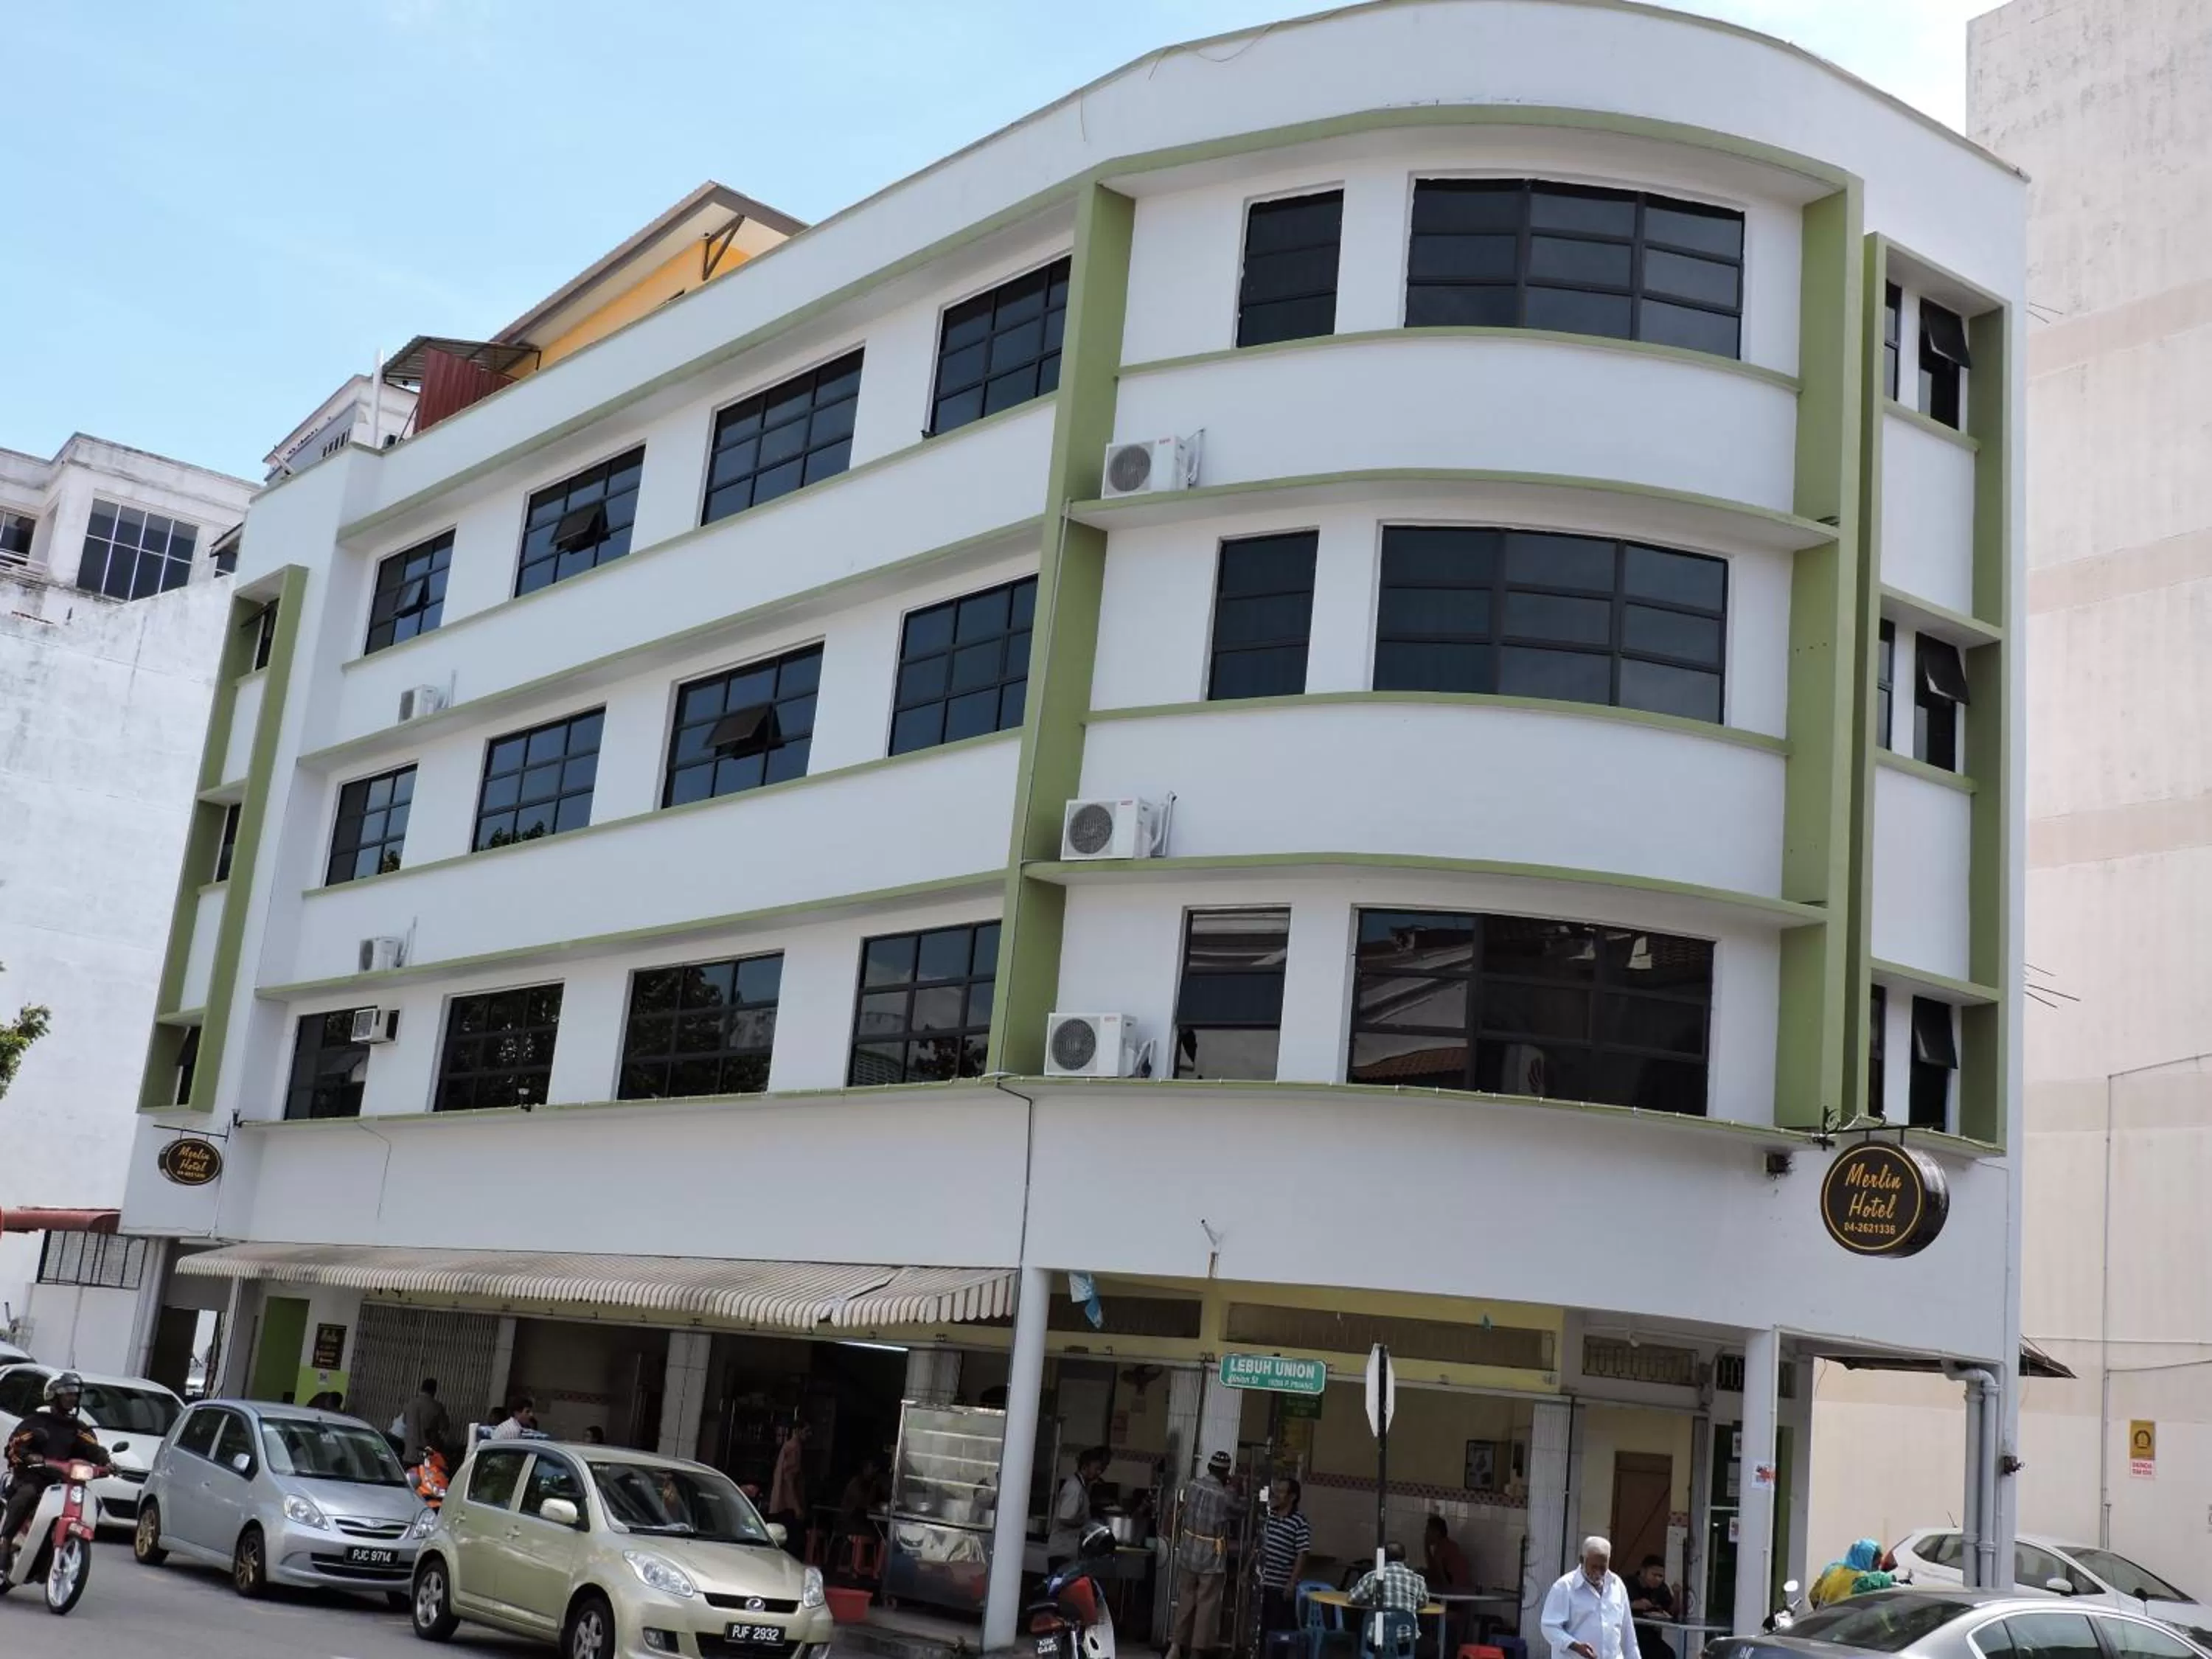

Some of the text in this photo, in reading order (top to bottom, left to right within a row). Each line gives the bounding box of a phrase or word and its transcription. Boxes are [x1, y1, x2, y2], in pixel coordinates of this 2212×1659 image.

[1845, 1163, 1902, 1189] Merlin
[1848, 1191, 1897, 1219] Hotel
[1230, 1357, 1315, 1379] LEBUH UNION
[352, 1548, 392, 1562] PJC 9714
[731, 1624, 751, 1638] PJF
